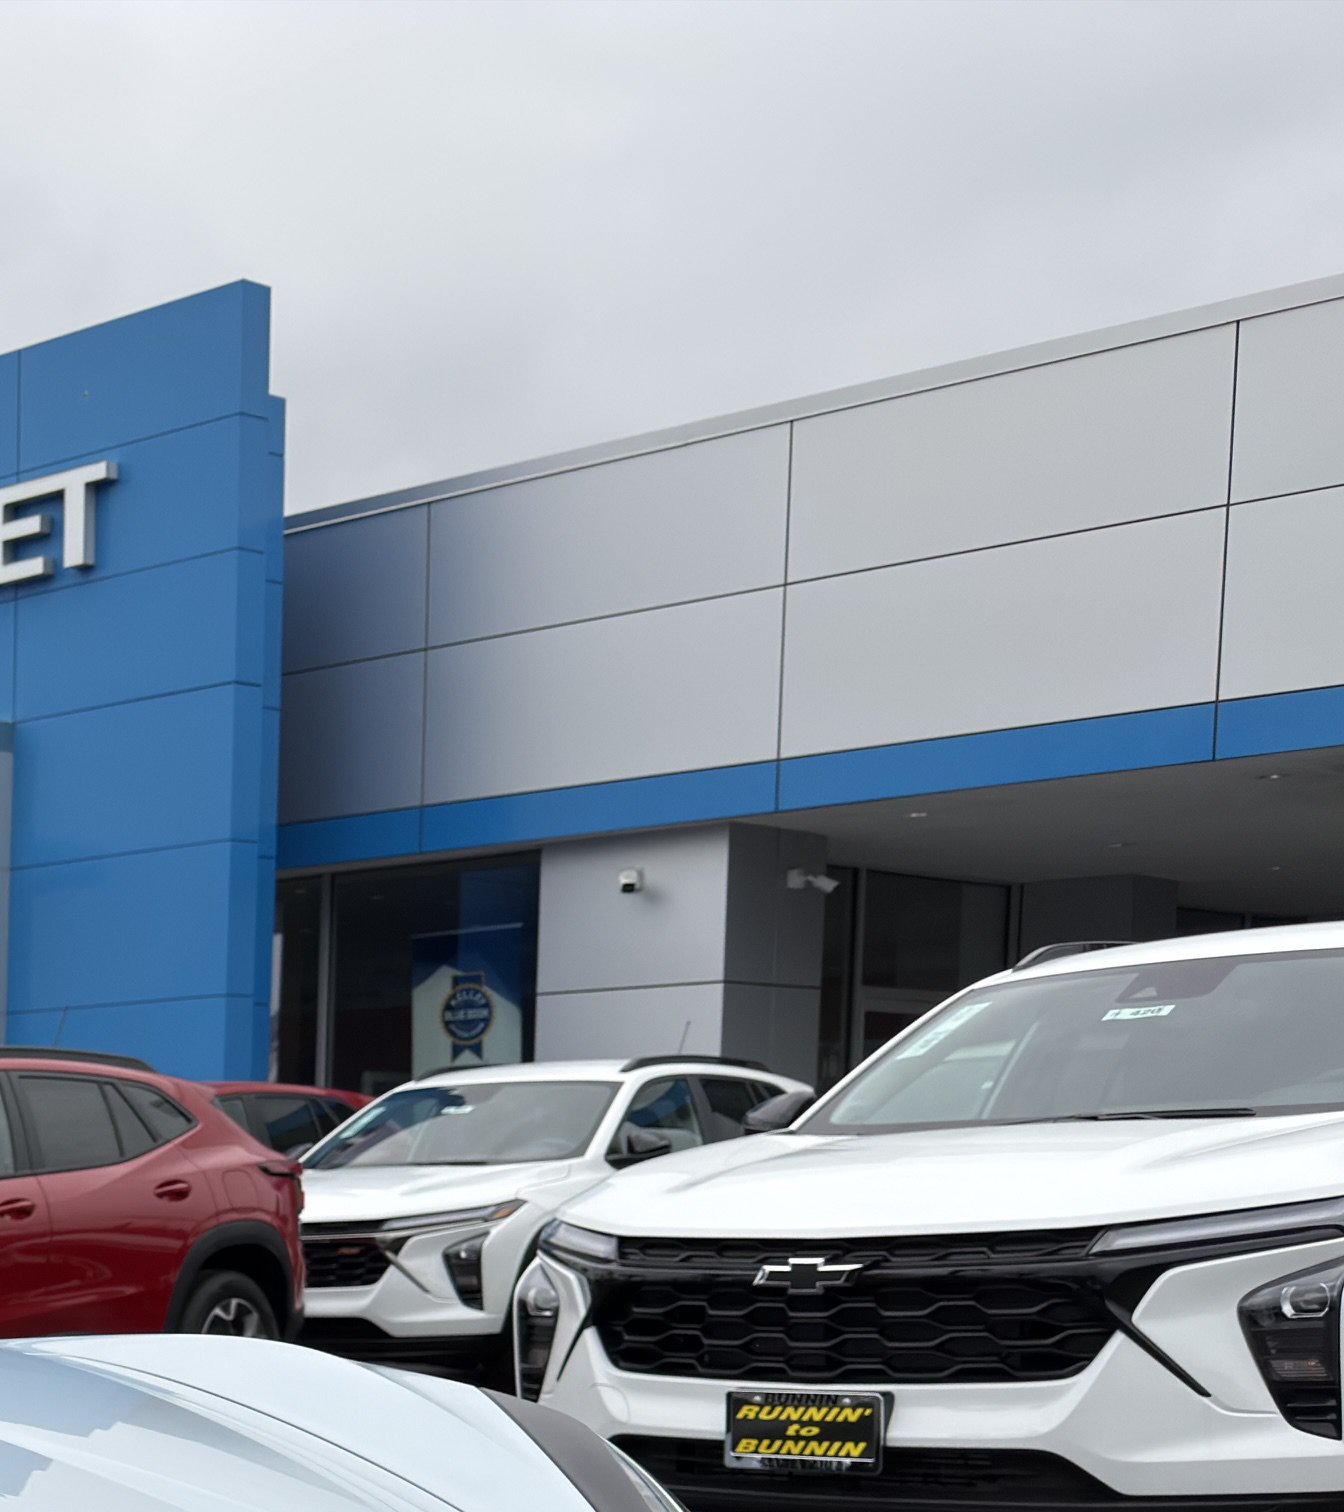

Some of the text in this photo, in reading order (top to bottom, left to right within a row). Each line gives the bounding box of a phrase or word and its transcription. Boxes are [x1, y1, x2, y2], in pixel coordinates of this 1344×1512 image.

[736, 1405, 872, 1422] RUNNIN'
[786, 1424, 820, 1436] to
[735, 1439, 866, 1456] BUNNIN
